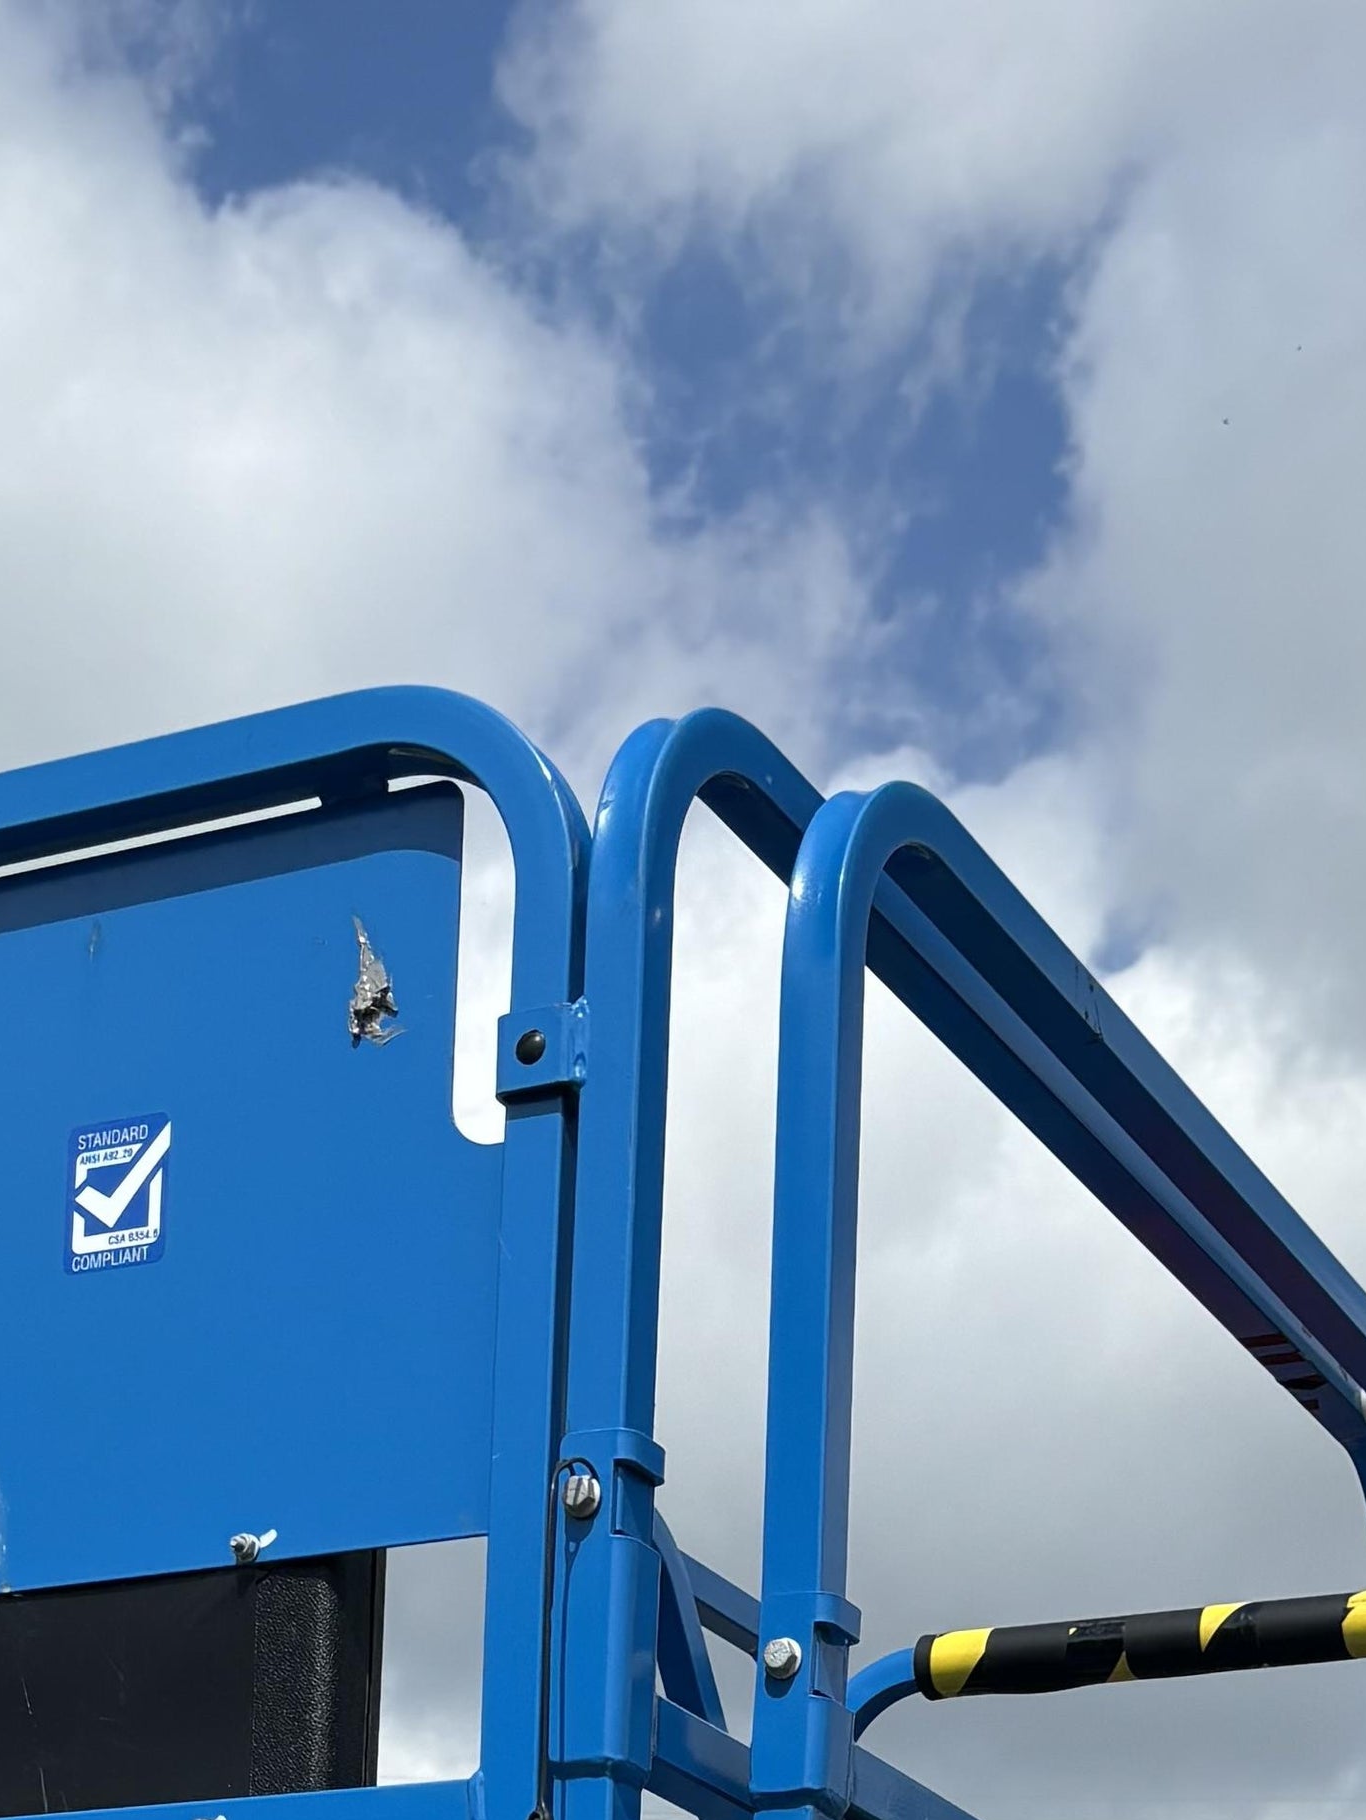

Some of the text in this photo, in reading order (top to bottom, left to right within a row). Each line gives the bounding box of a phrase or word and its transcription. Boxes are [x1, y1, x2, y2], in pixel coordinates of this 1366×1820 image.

[78, 1124, 149, 1150] STANDARD
[79, 1154, 101, 1166] ANSI
[108, 1235, 126, 1245] CSA
[72, 1246, 149, 1272] COMPLIANT
